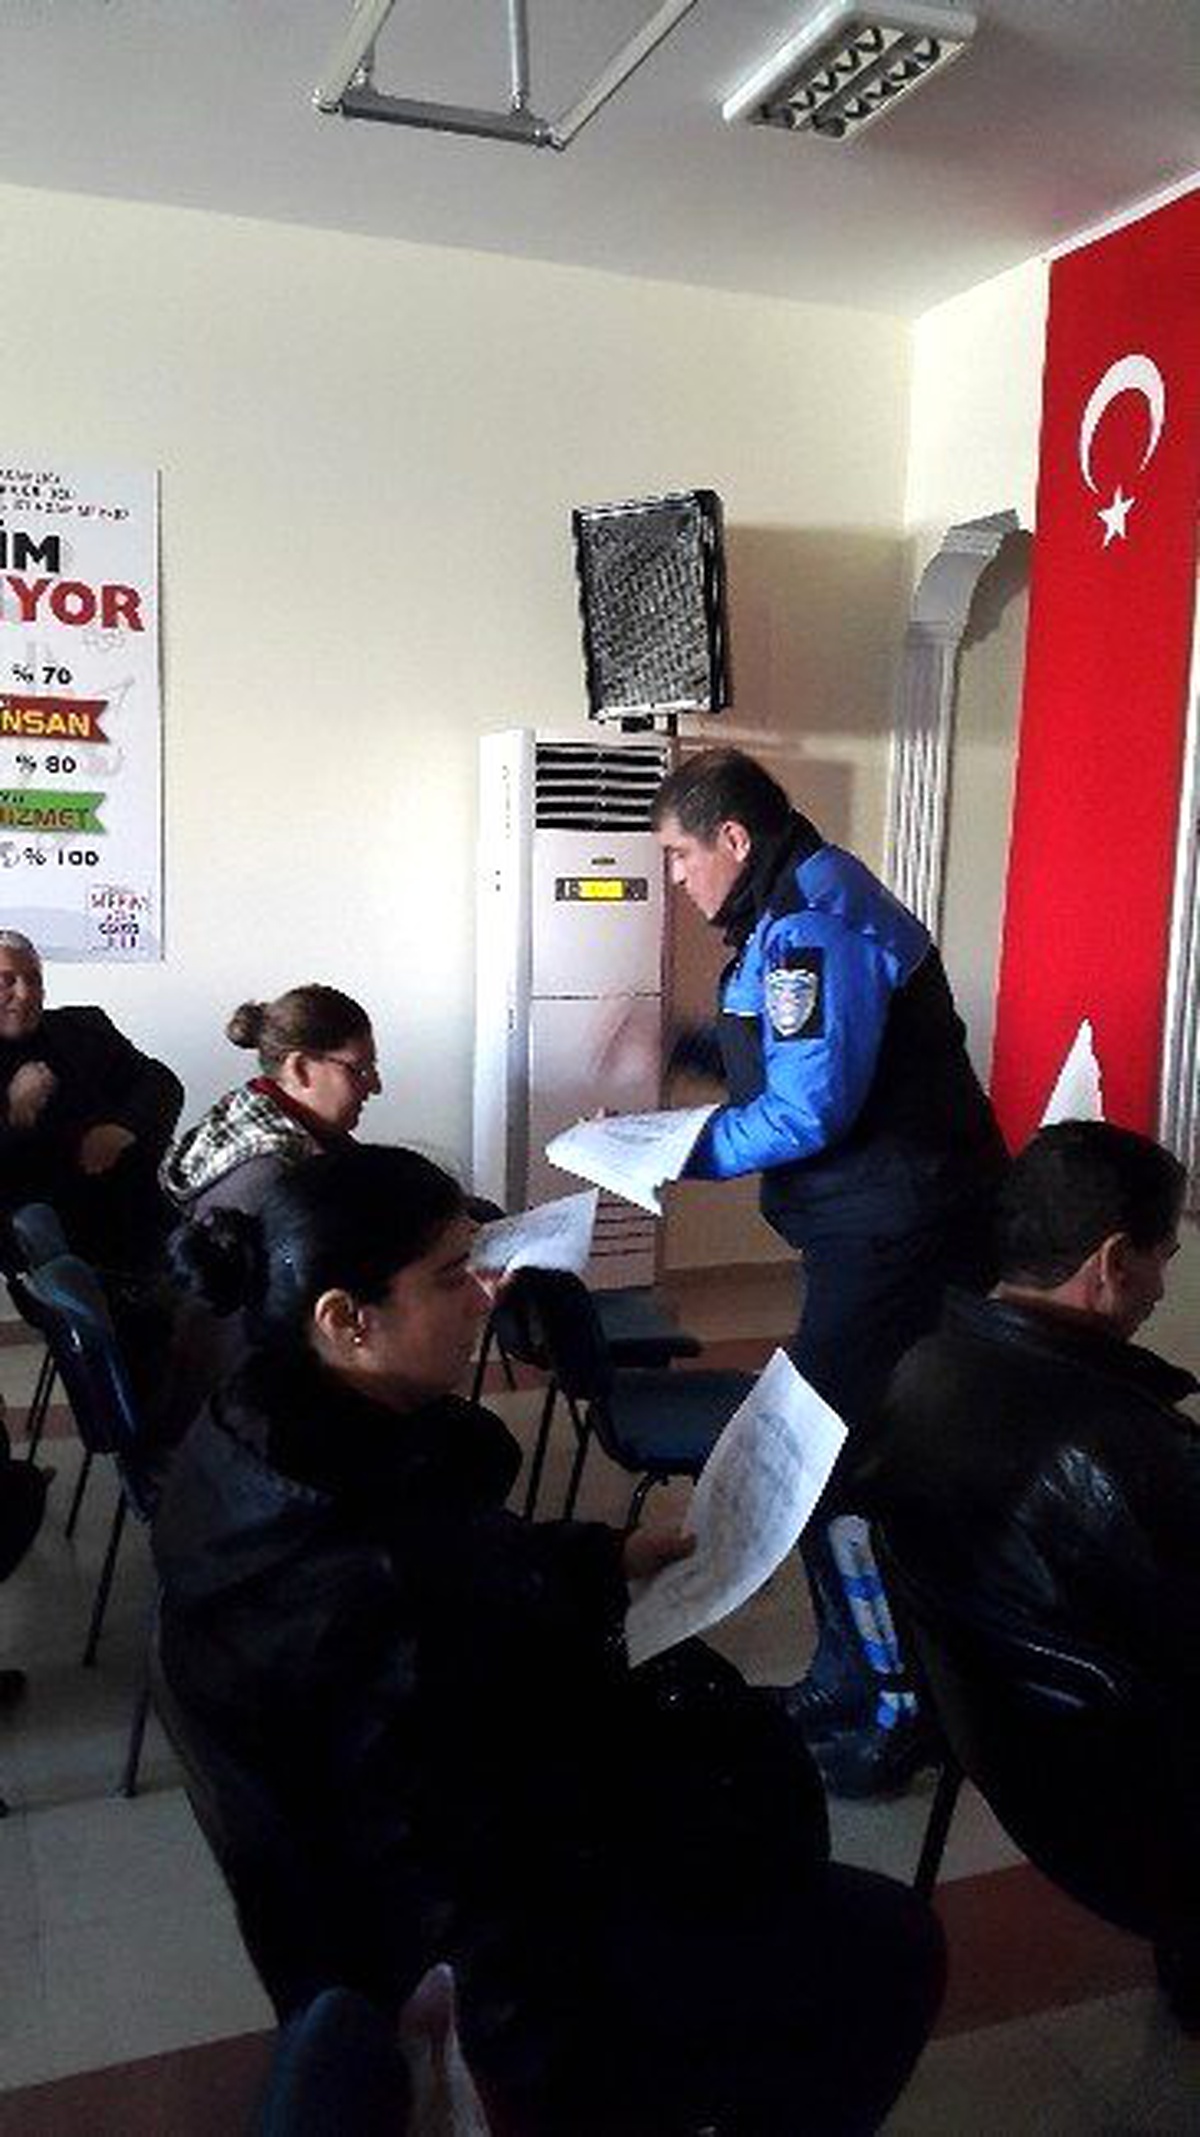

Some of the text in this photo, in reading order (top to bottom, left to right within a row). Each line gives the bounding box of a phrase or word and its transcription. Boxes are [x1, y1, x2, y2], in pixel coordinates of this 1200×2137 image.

[0, 575, 145, 632] YOR
[42, 667, 73, 685] 70
[45, 755, 77, 774] 80
[58, 849, 100, 867] 100
